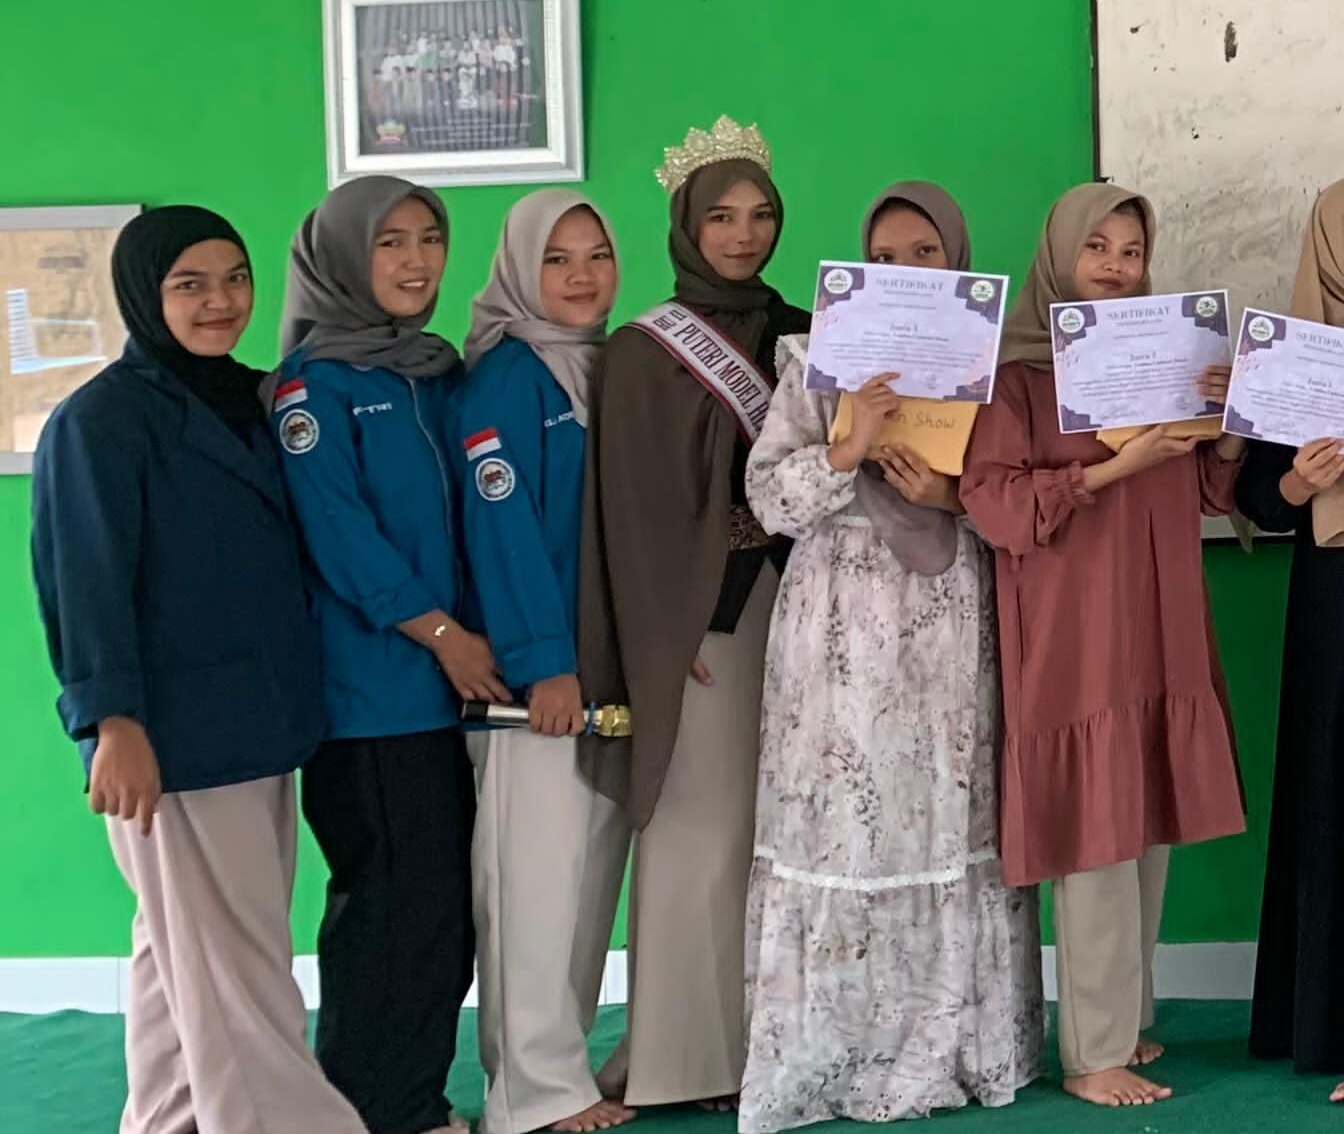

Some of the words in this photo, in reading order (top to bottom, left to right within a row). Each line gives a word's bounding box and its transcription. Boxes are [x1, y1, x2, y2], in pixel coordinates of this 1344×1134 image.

[673, 323, 729, 369] PUTERI
[714, 361, 762, 409] MODEL
[914, 411, 957, 429] Show
